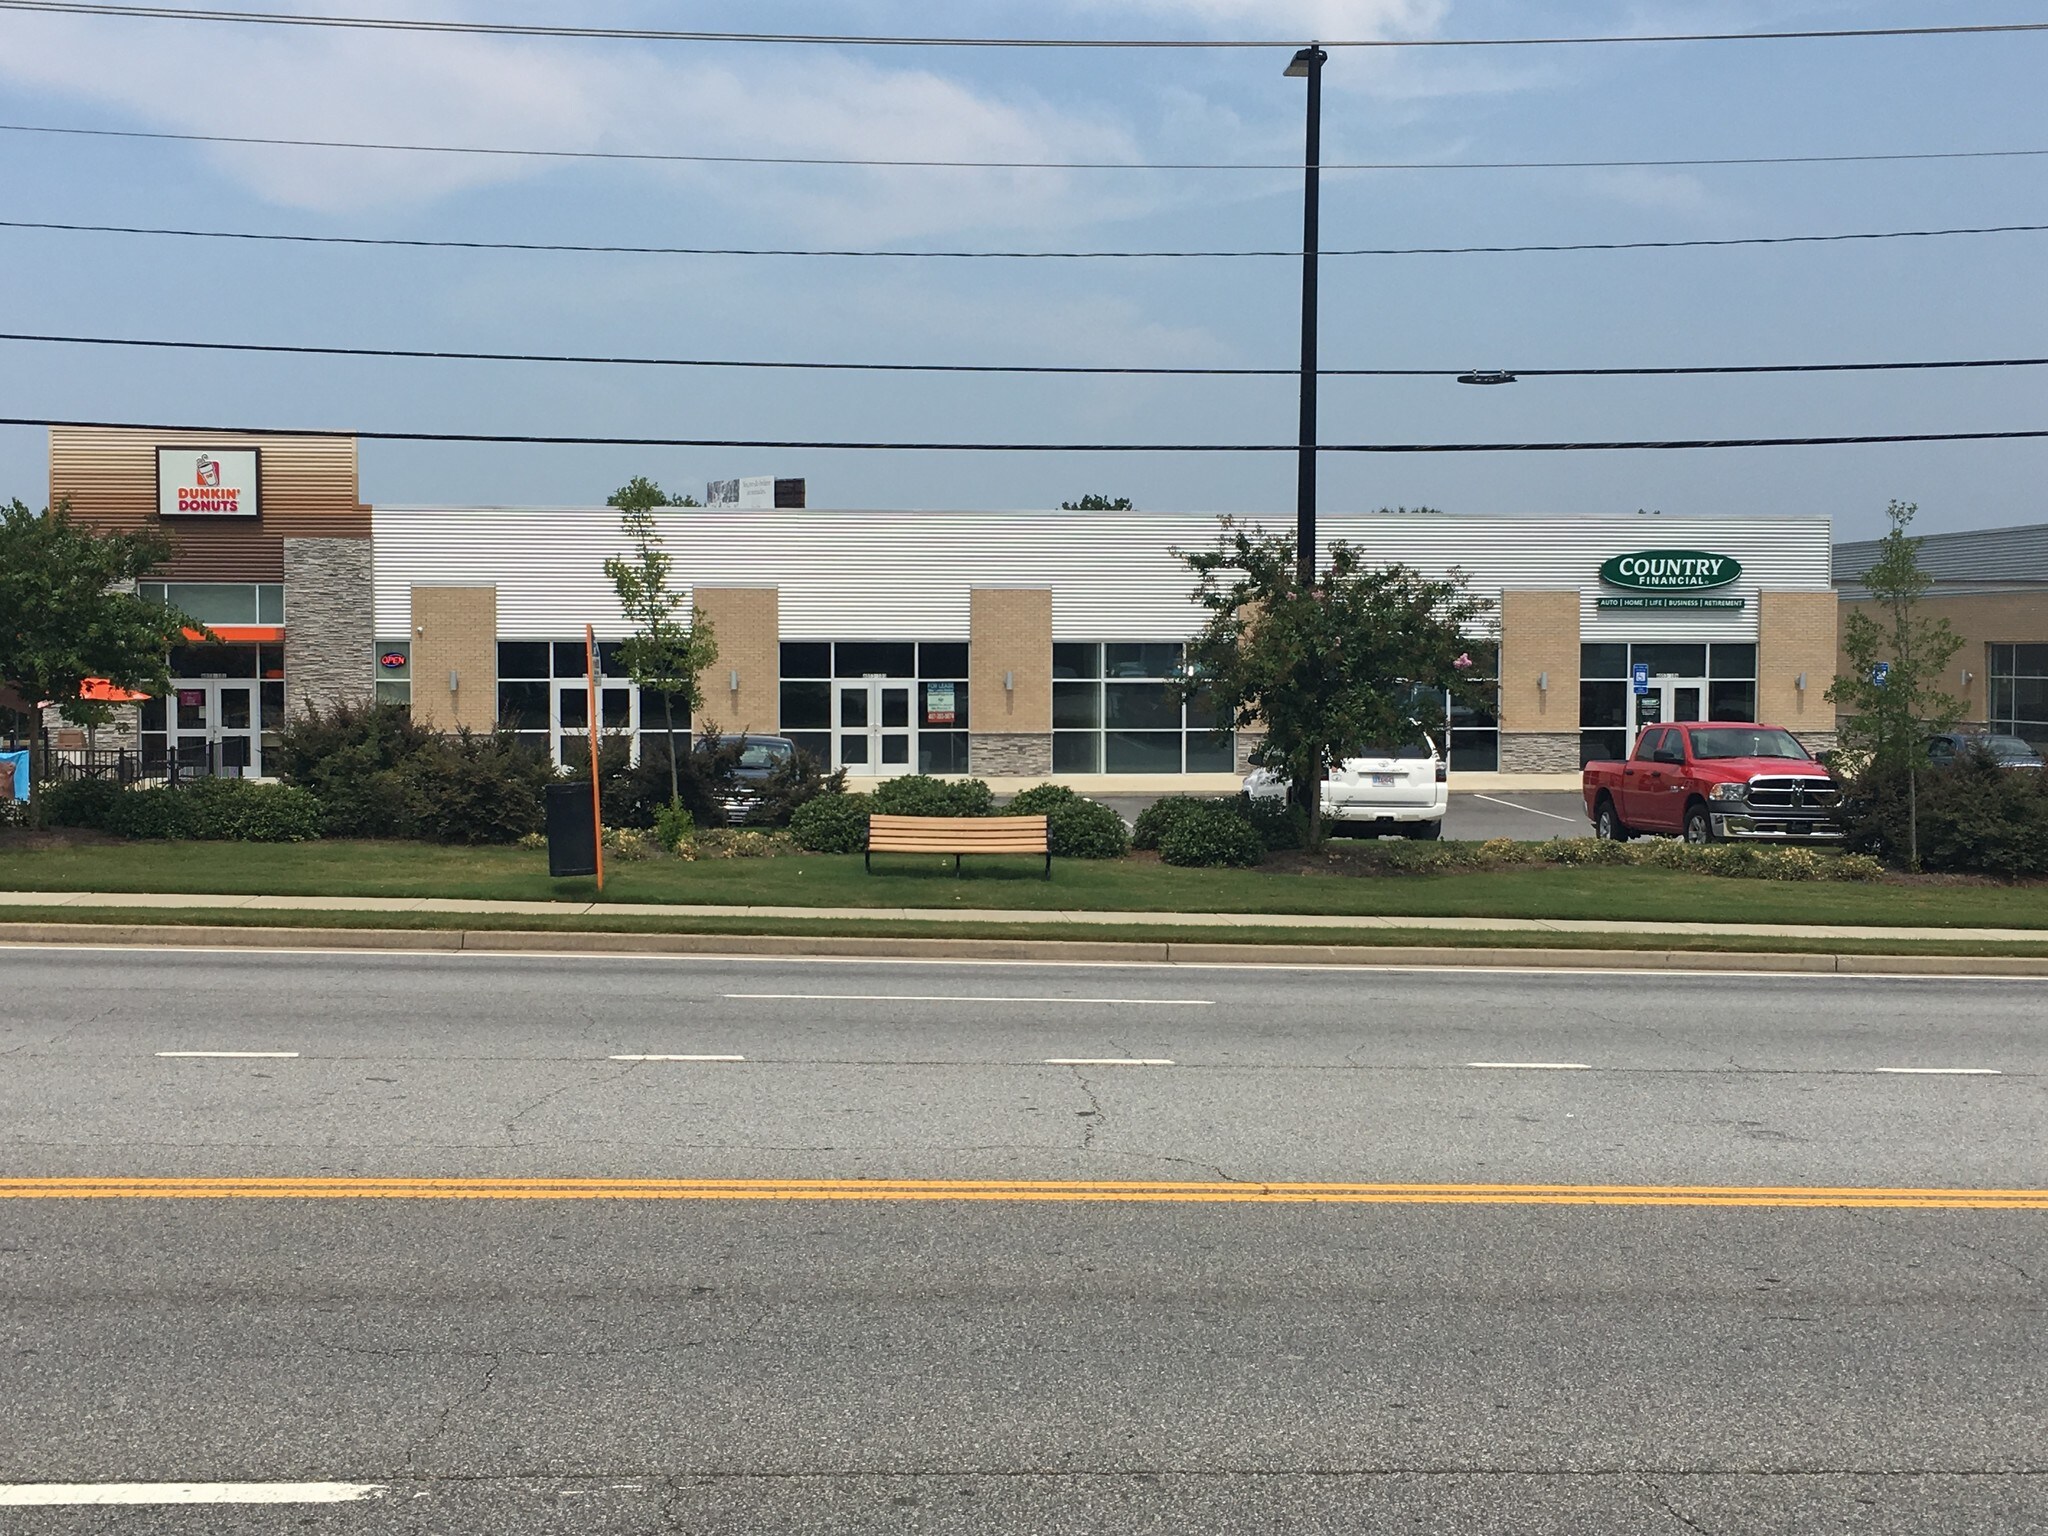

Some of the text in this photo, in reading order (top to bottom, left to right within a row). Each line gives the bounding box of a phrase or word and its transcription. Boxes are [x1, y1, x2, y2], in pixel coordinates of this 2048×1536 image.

[178, 488, 240, 499] DUNKIN'
[178, 500, 238, 511] DONUTS
[1619, 558, 1723, 576] COUNTRY
[1639, 576, 1704, 585] FINANCIAL
[382, 656, 405, 664] OPEN
